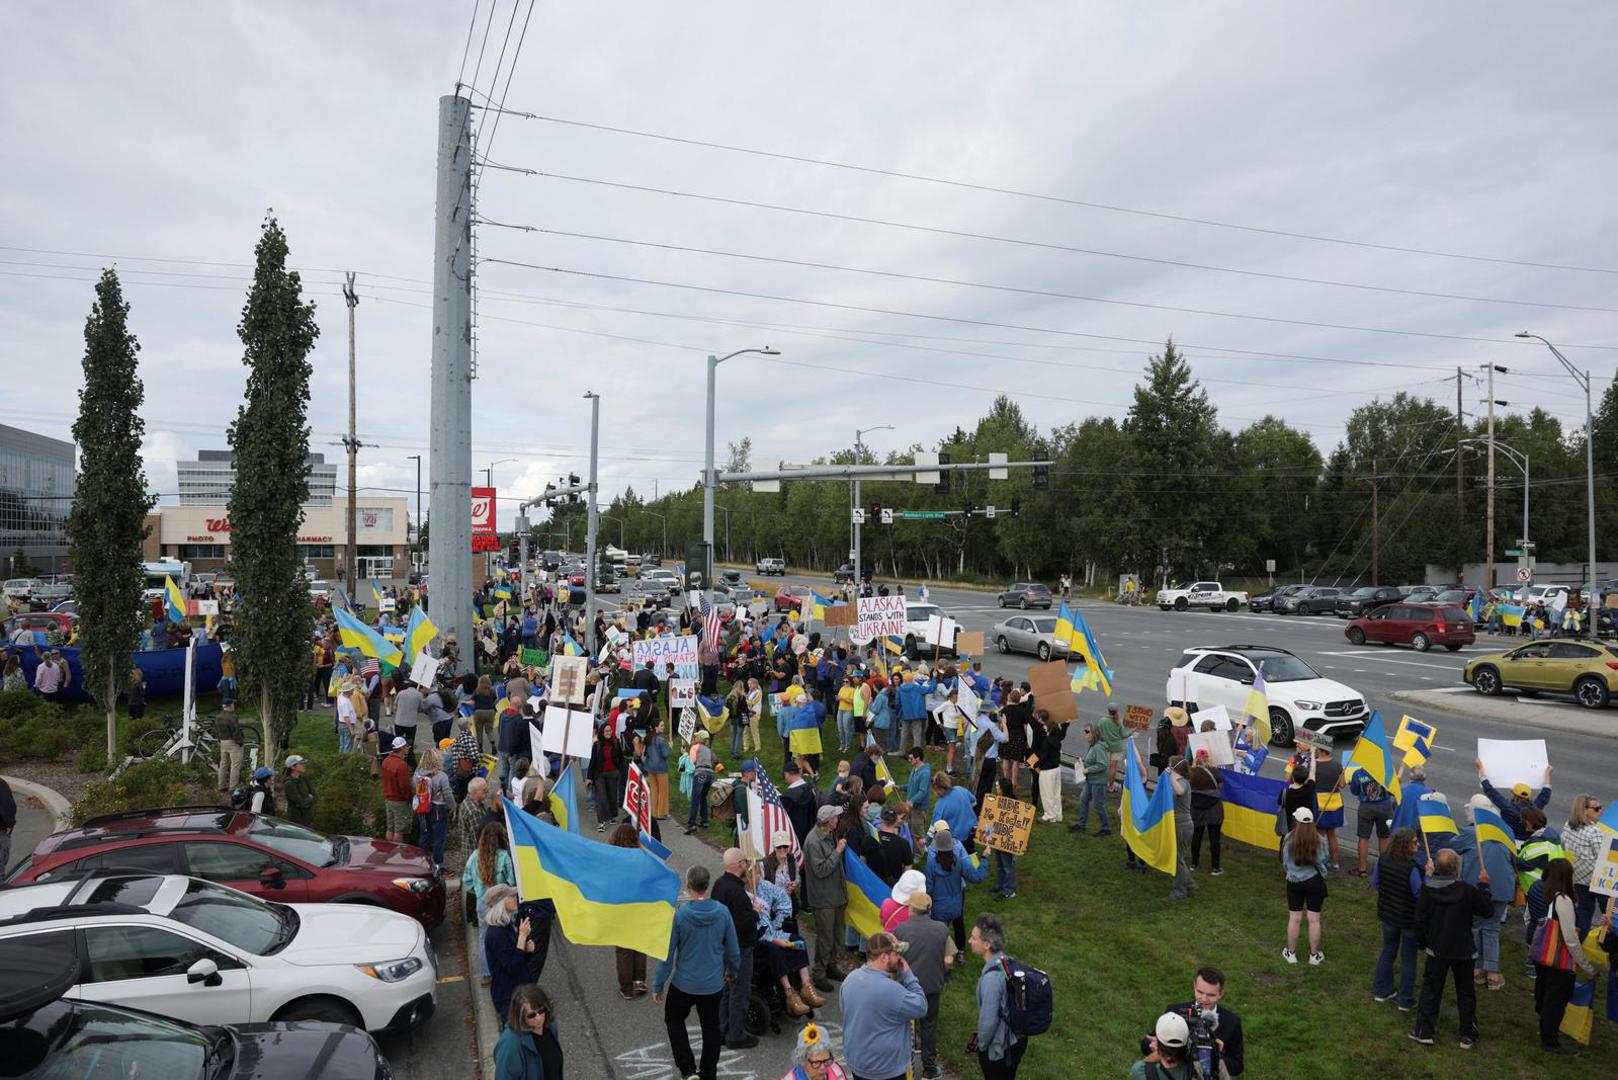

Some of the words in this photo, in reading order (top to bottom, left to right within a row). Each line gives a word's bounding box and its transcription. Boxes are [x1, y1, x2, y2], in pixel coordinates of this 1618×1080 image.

[860, 596, 905, 613] ALASKA
[859, 612, 883, 622] STANDS
[886, 611, 904, 620] WITH
[860, 620, 906, 638] UKRAINE
[998, 797, 1020, 815] HIDE
[993, 821, 1014, 839] HIDE
